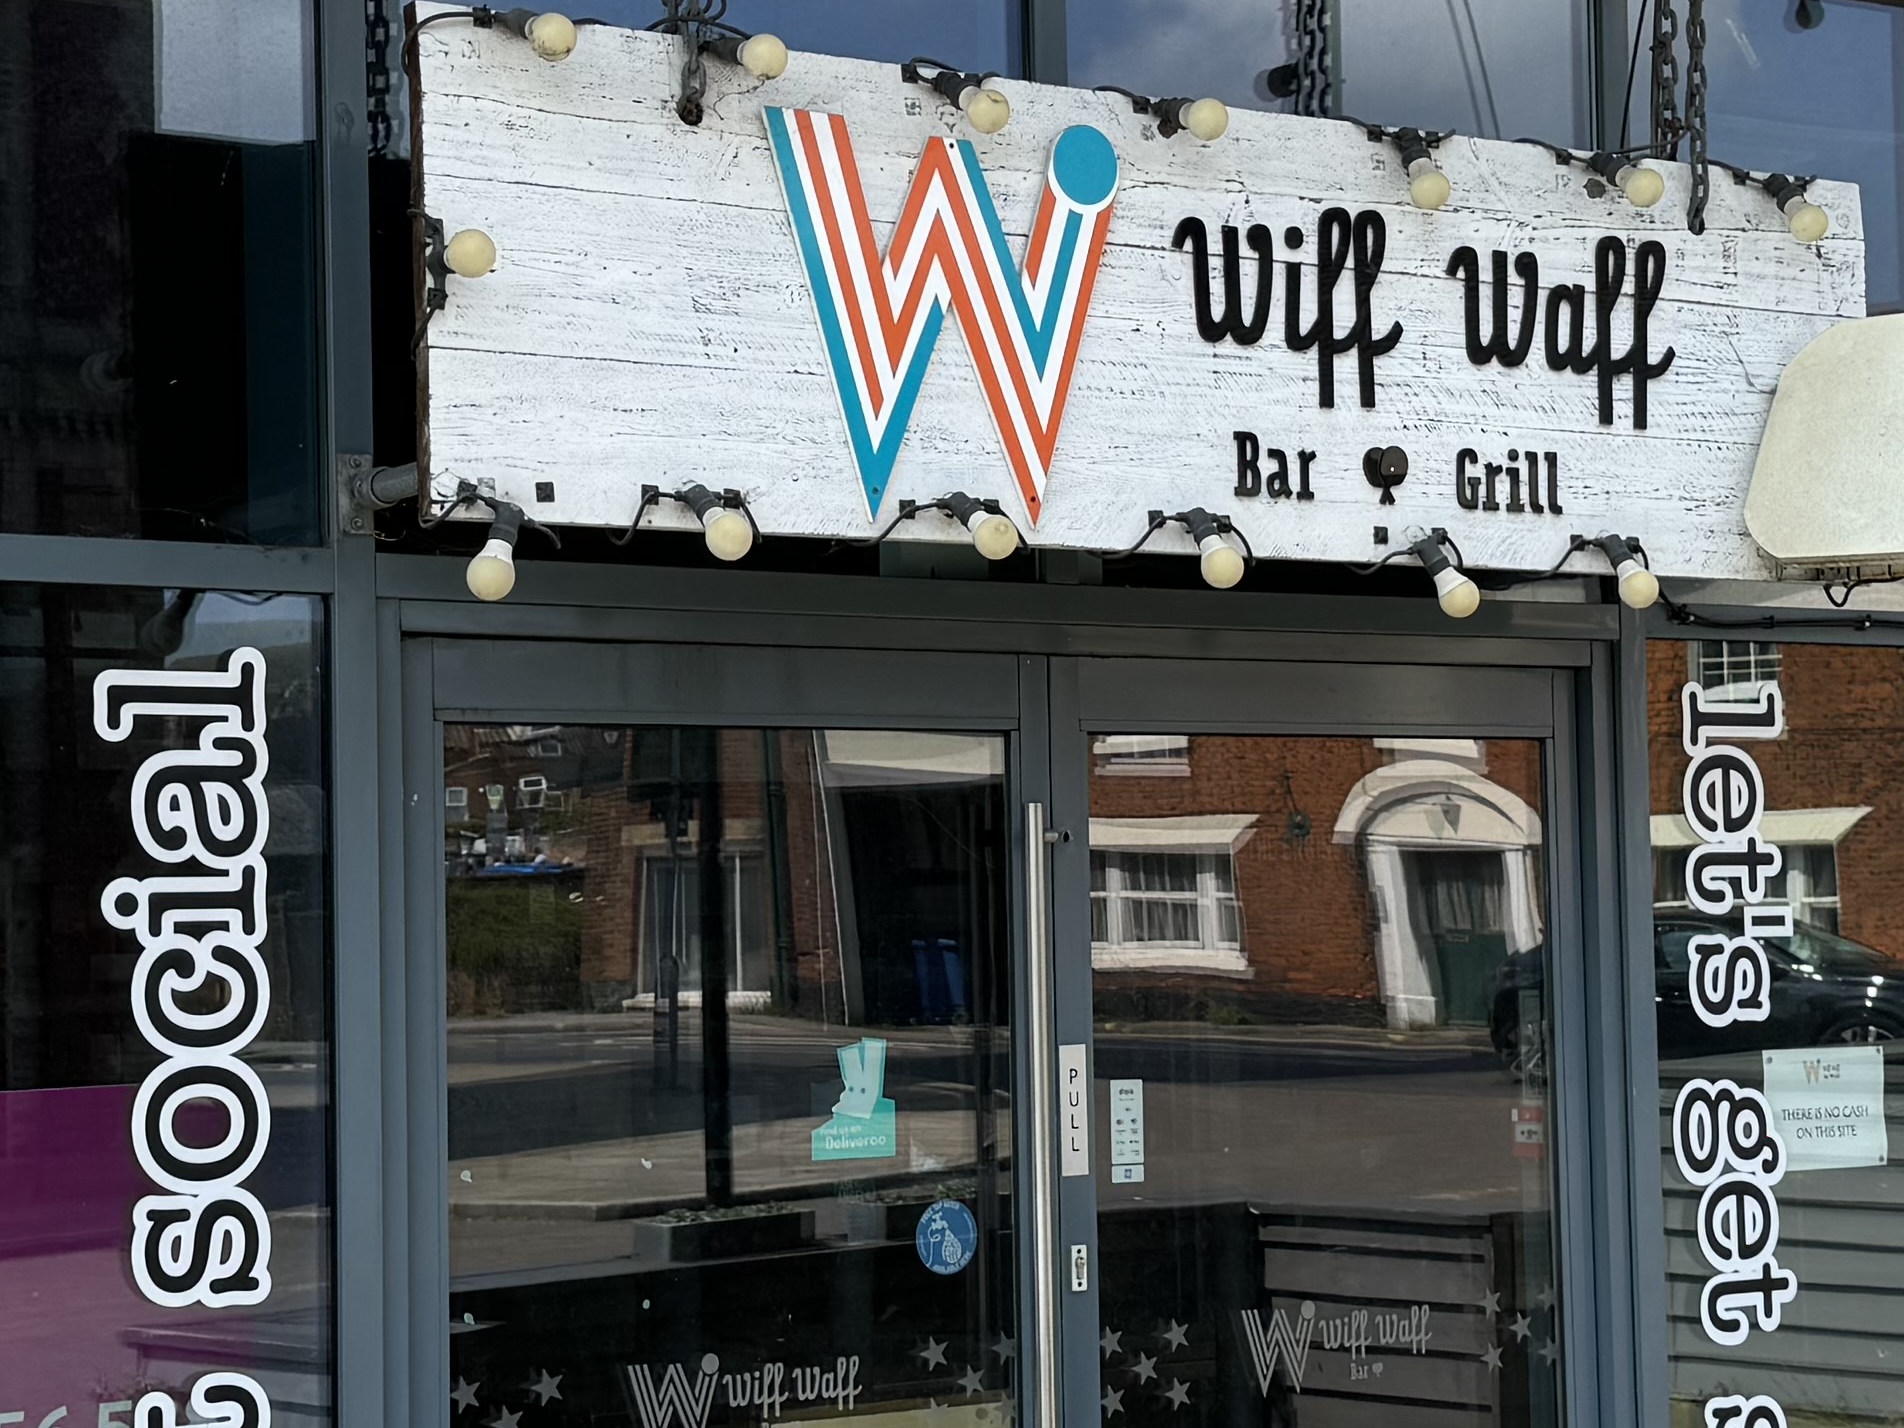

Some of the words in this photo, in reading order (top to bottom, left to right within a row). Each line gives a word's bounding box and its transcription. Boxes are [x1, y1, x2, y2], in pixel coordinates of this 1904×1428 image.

[1172, 206, 1404, 411] Wiff
[1446, 233, 1677, 431] Waff
[1232, 429, 1315, 504] Bar
[1454, 447, 1564, 518] Grill
[1681, 680, 1794, 1028] let's
[93, 646, 272, 1309] social
[825, 1134, 887, 1150] Deliveroo
[1068, 1067, 1081, 1152] PULL
[1781, 1107, 1813, 1121] THERE
[1814, 1107, 1822, 1120] IS
[1824, 1105, 1841, 1119] NO
[1842, 1105, 1869, 1118] CASH
[1796, 1127, 1813, 1140] ON
[1815, 1125, 1836, 1139] THIS
[1837, 1124, 1858, 1138] SITE
[1672, 1077, 1797, 1346] get
[722, 1361, 789, 1419] Wiff
[791, 1355, 863, 1411] Waff
